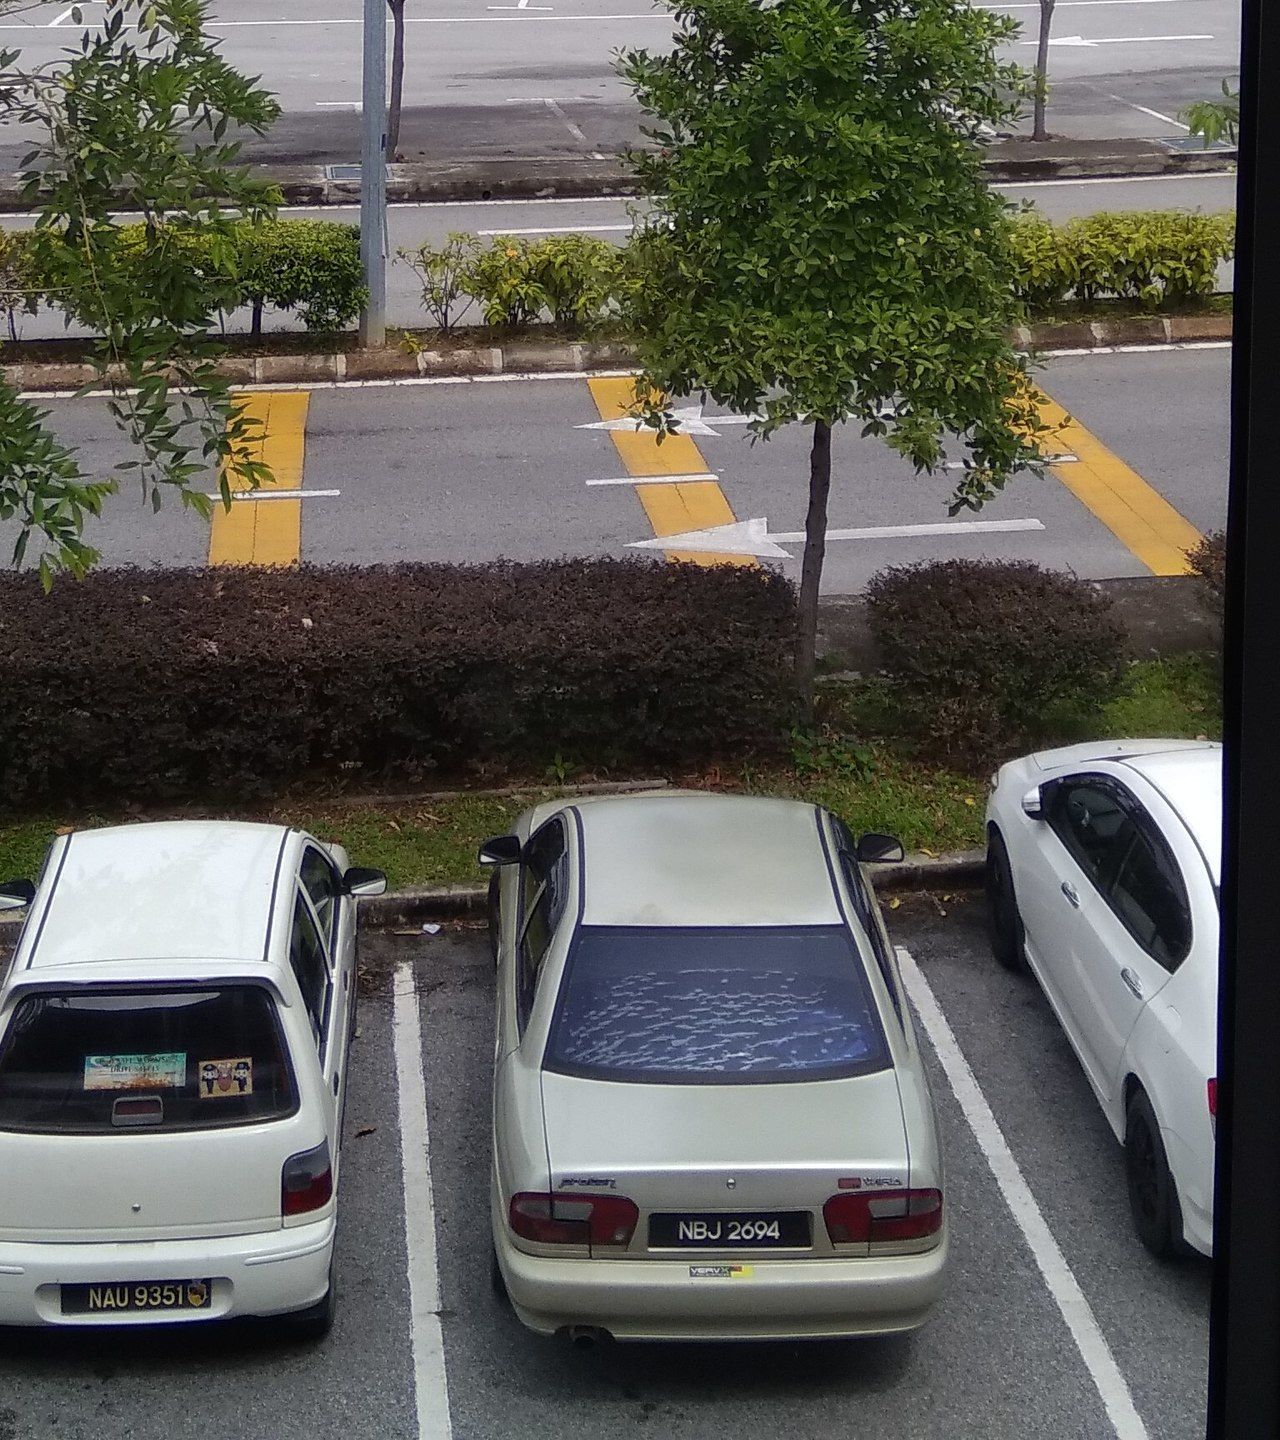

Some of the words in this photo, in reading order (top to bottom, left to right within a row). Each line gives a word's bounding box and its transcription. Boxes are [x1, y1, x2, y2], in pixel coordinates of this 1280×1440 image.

[679, 1220, 722, 1240] NBJ
[728, 1220, 780, 1240] 2694
[89, 1286, 129, 1308] NAU
[135, 1285, 183, 1307] 9351
